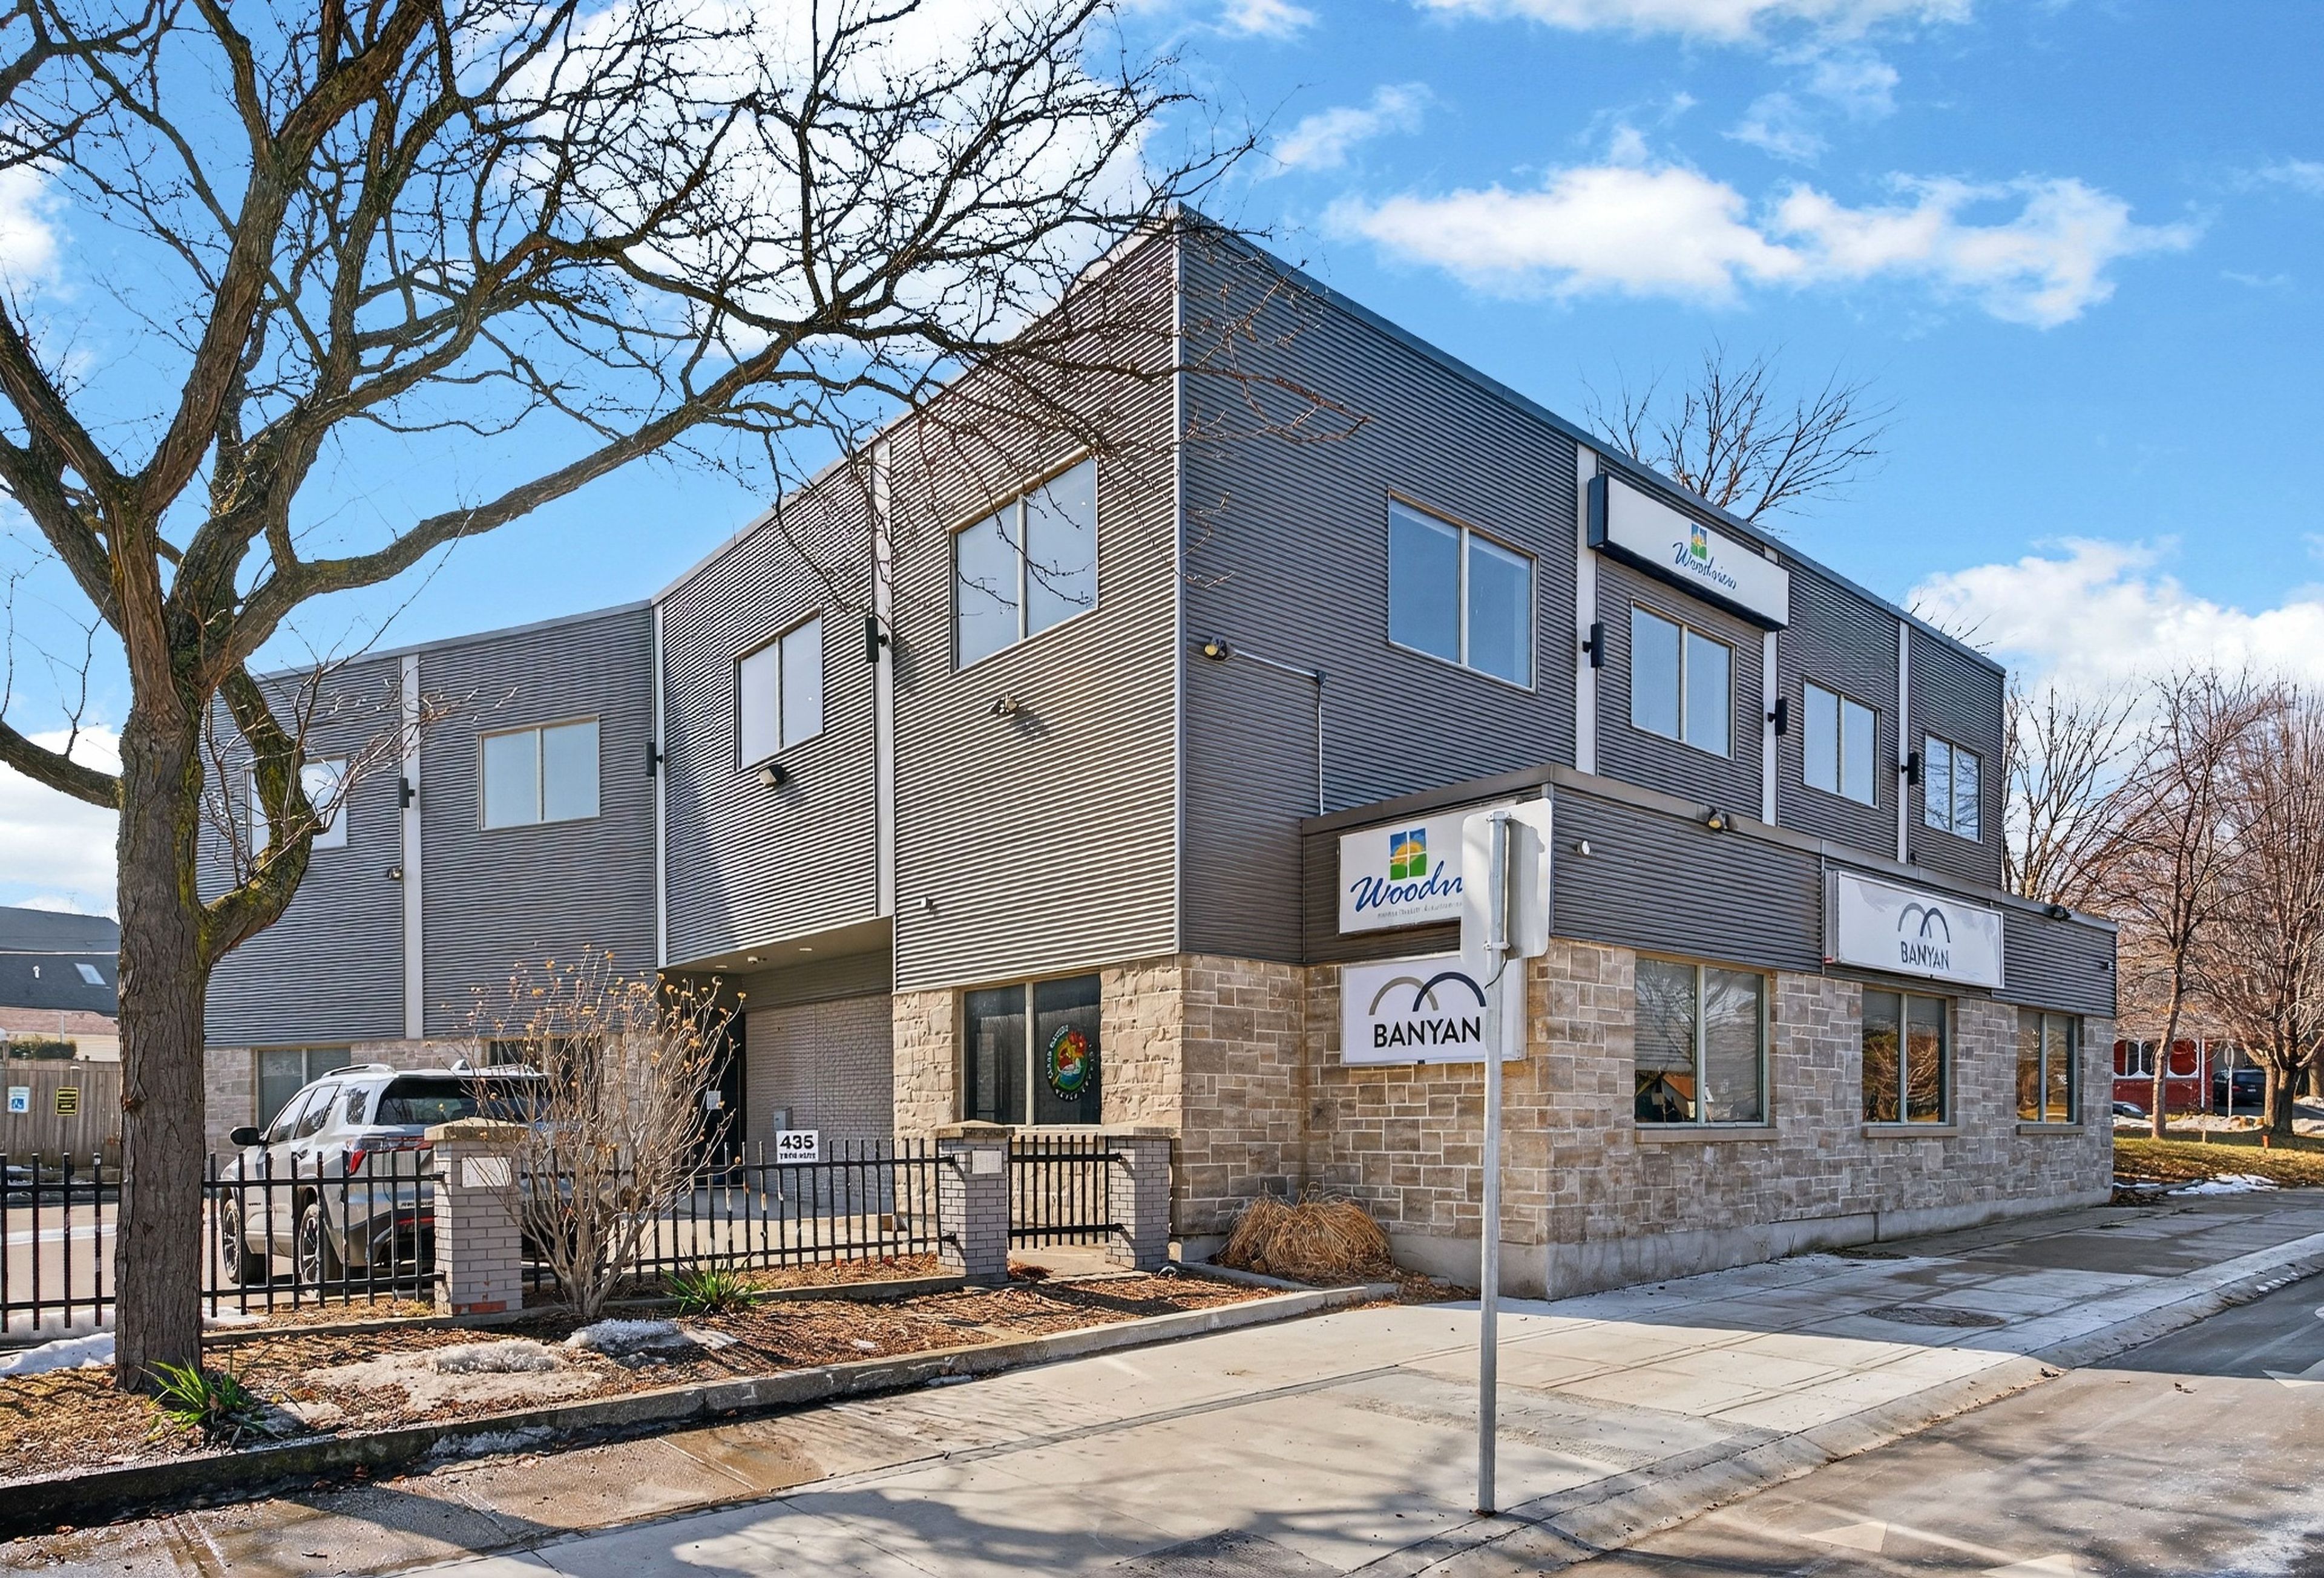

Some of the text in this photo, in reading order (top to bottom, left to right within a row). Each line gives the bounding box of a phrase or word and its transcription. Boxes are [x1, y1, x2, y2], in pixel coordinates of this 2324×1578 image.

[1900, 941, 1950, 971] BANYAN
[1373, 1016, 1481, 1048] BANYAN
[780, 1134, 814, 1150] 435
